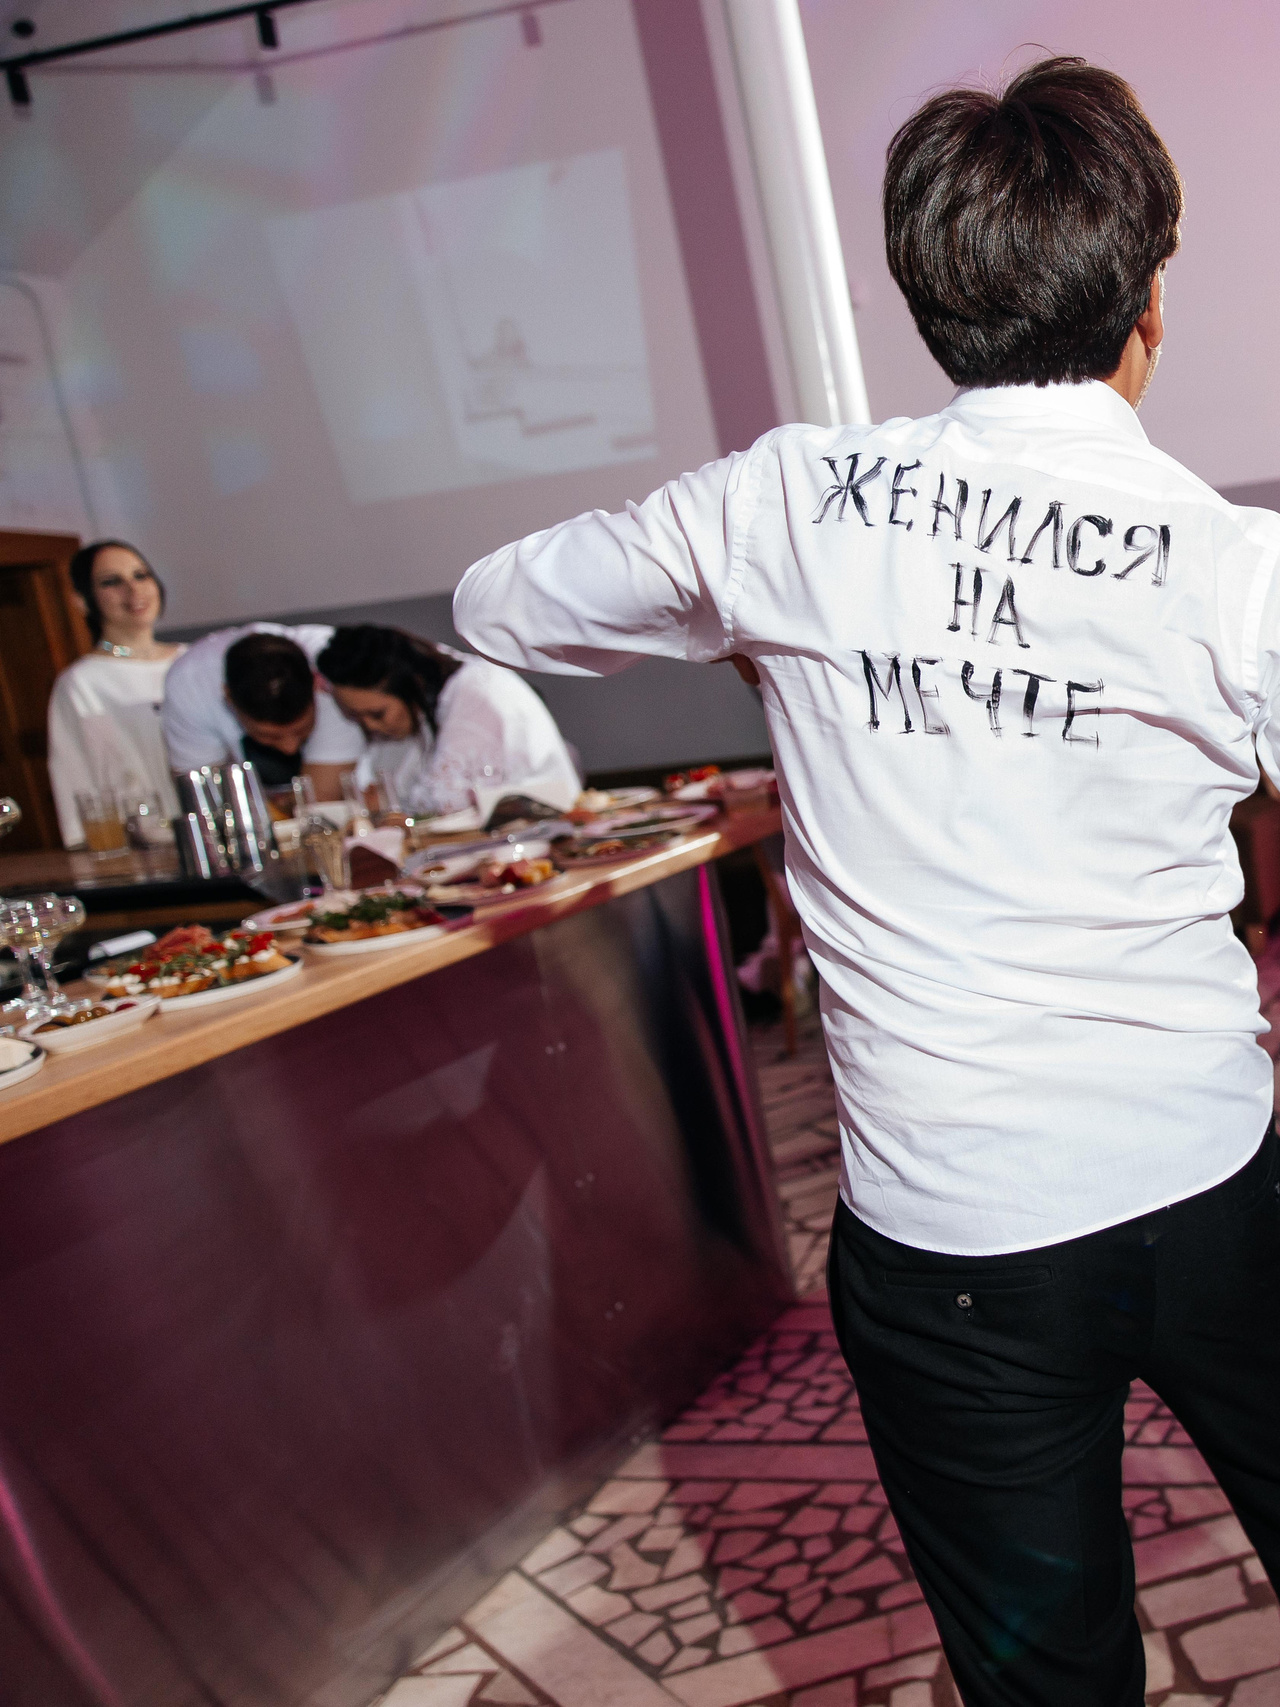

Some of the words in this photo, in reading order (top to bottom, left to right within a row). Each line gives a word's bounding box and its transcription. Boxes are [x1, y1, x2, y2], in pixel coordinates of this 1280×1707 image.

[811, 453, 1172, 586] ЖЕНИЛСЯ
[946, 562, 1030, 648] НА
[852, 650, 1104, 749] МЕЧТЕ
